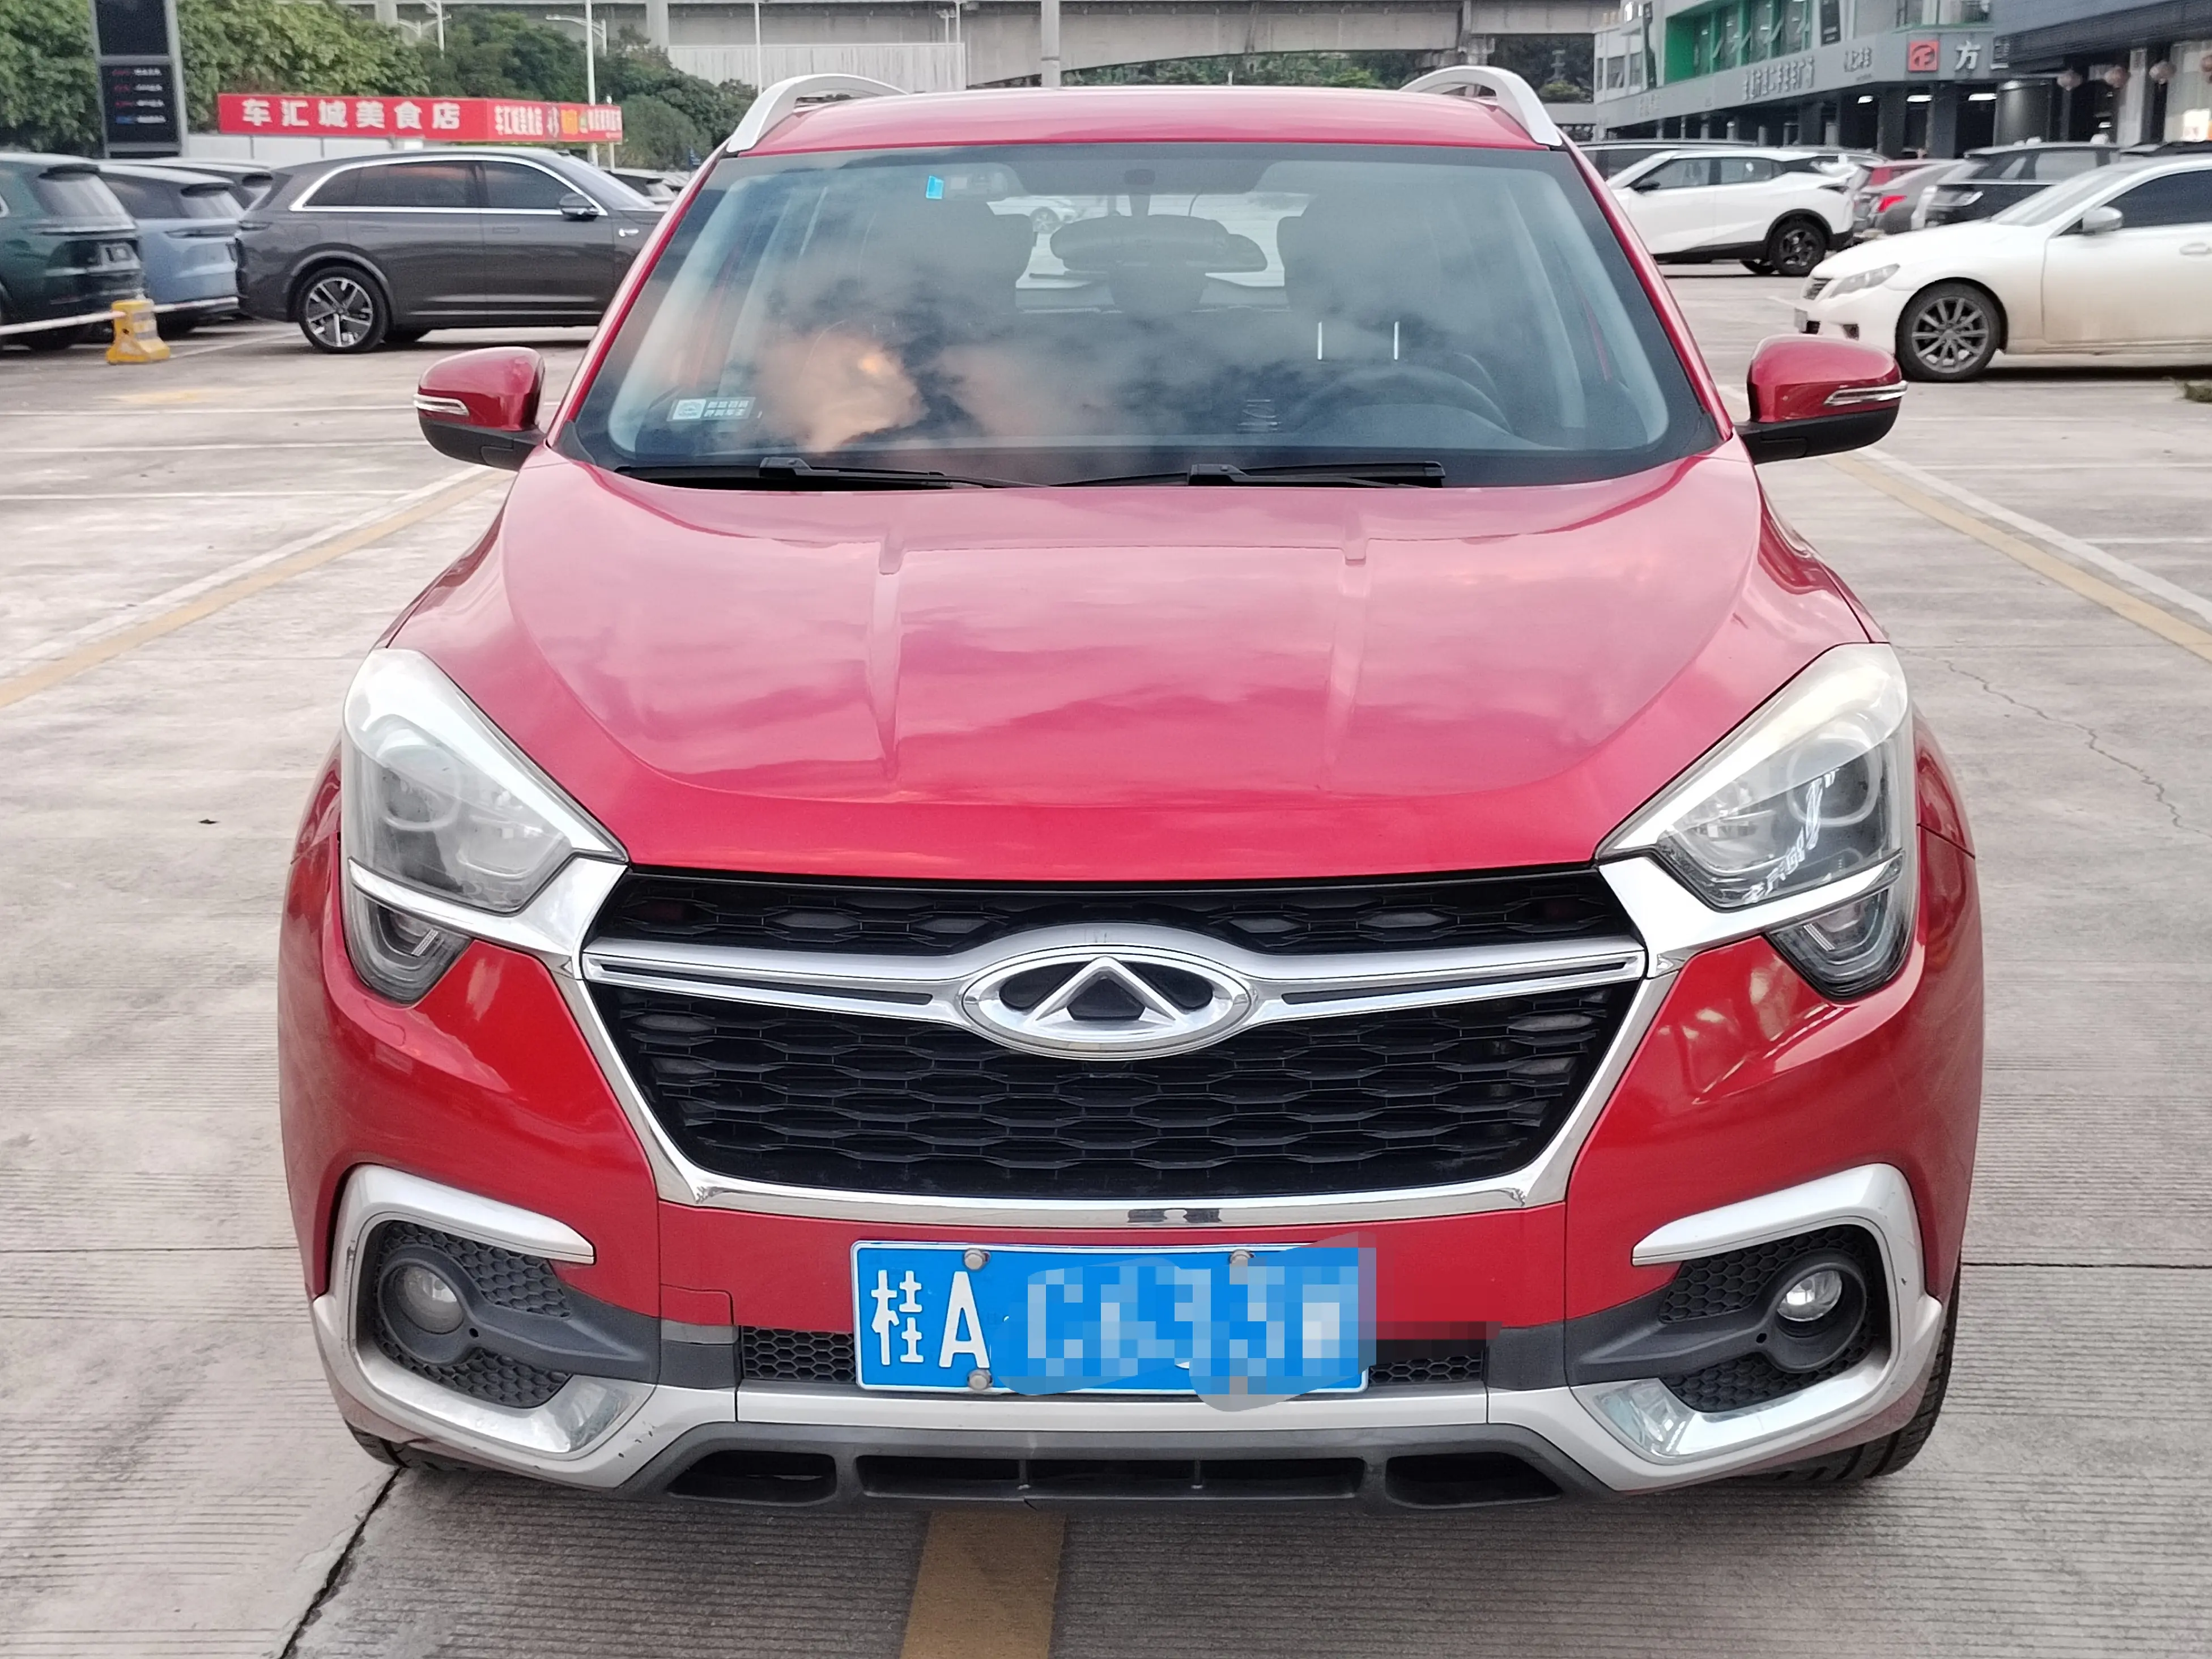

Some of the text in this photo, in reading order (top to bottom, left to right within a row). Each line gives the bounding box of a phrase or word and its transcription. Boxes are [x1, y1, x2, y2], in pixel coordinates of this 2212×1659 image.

[242, 98, 460, 130] 车汇城美食店
